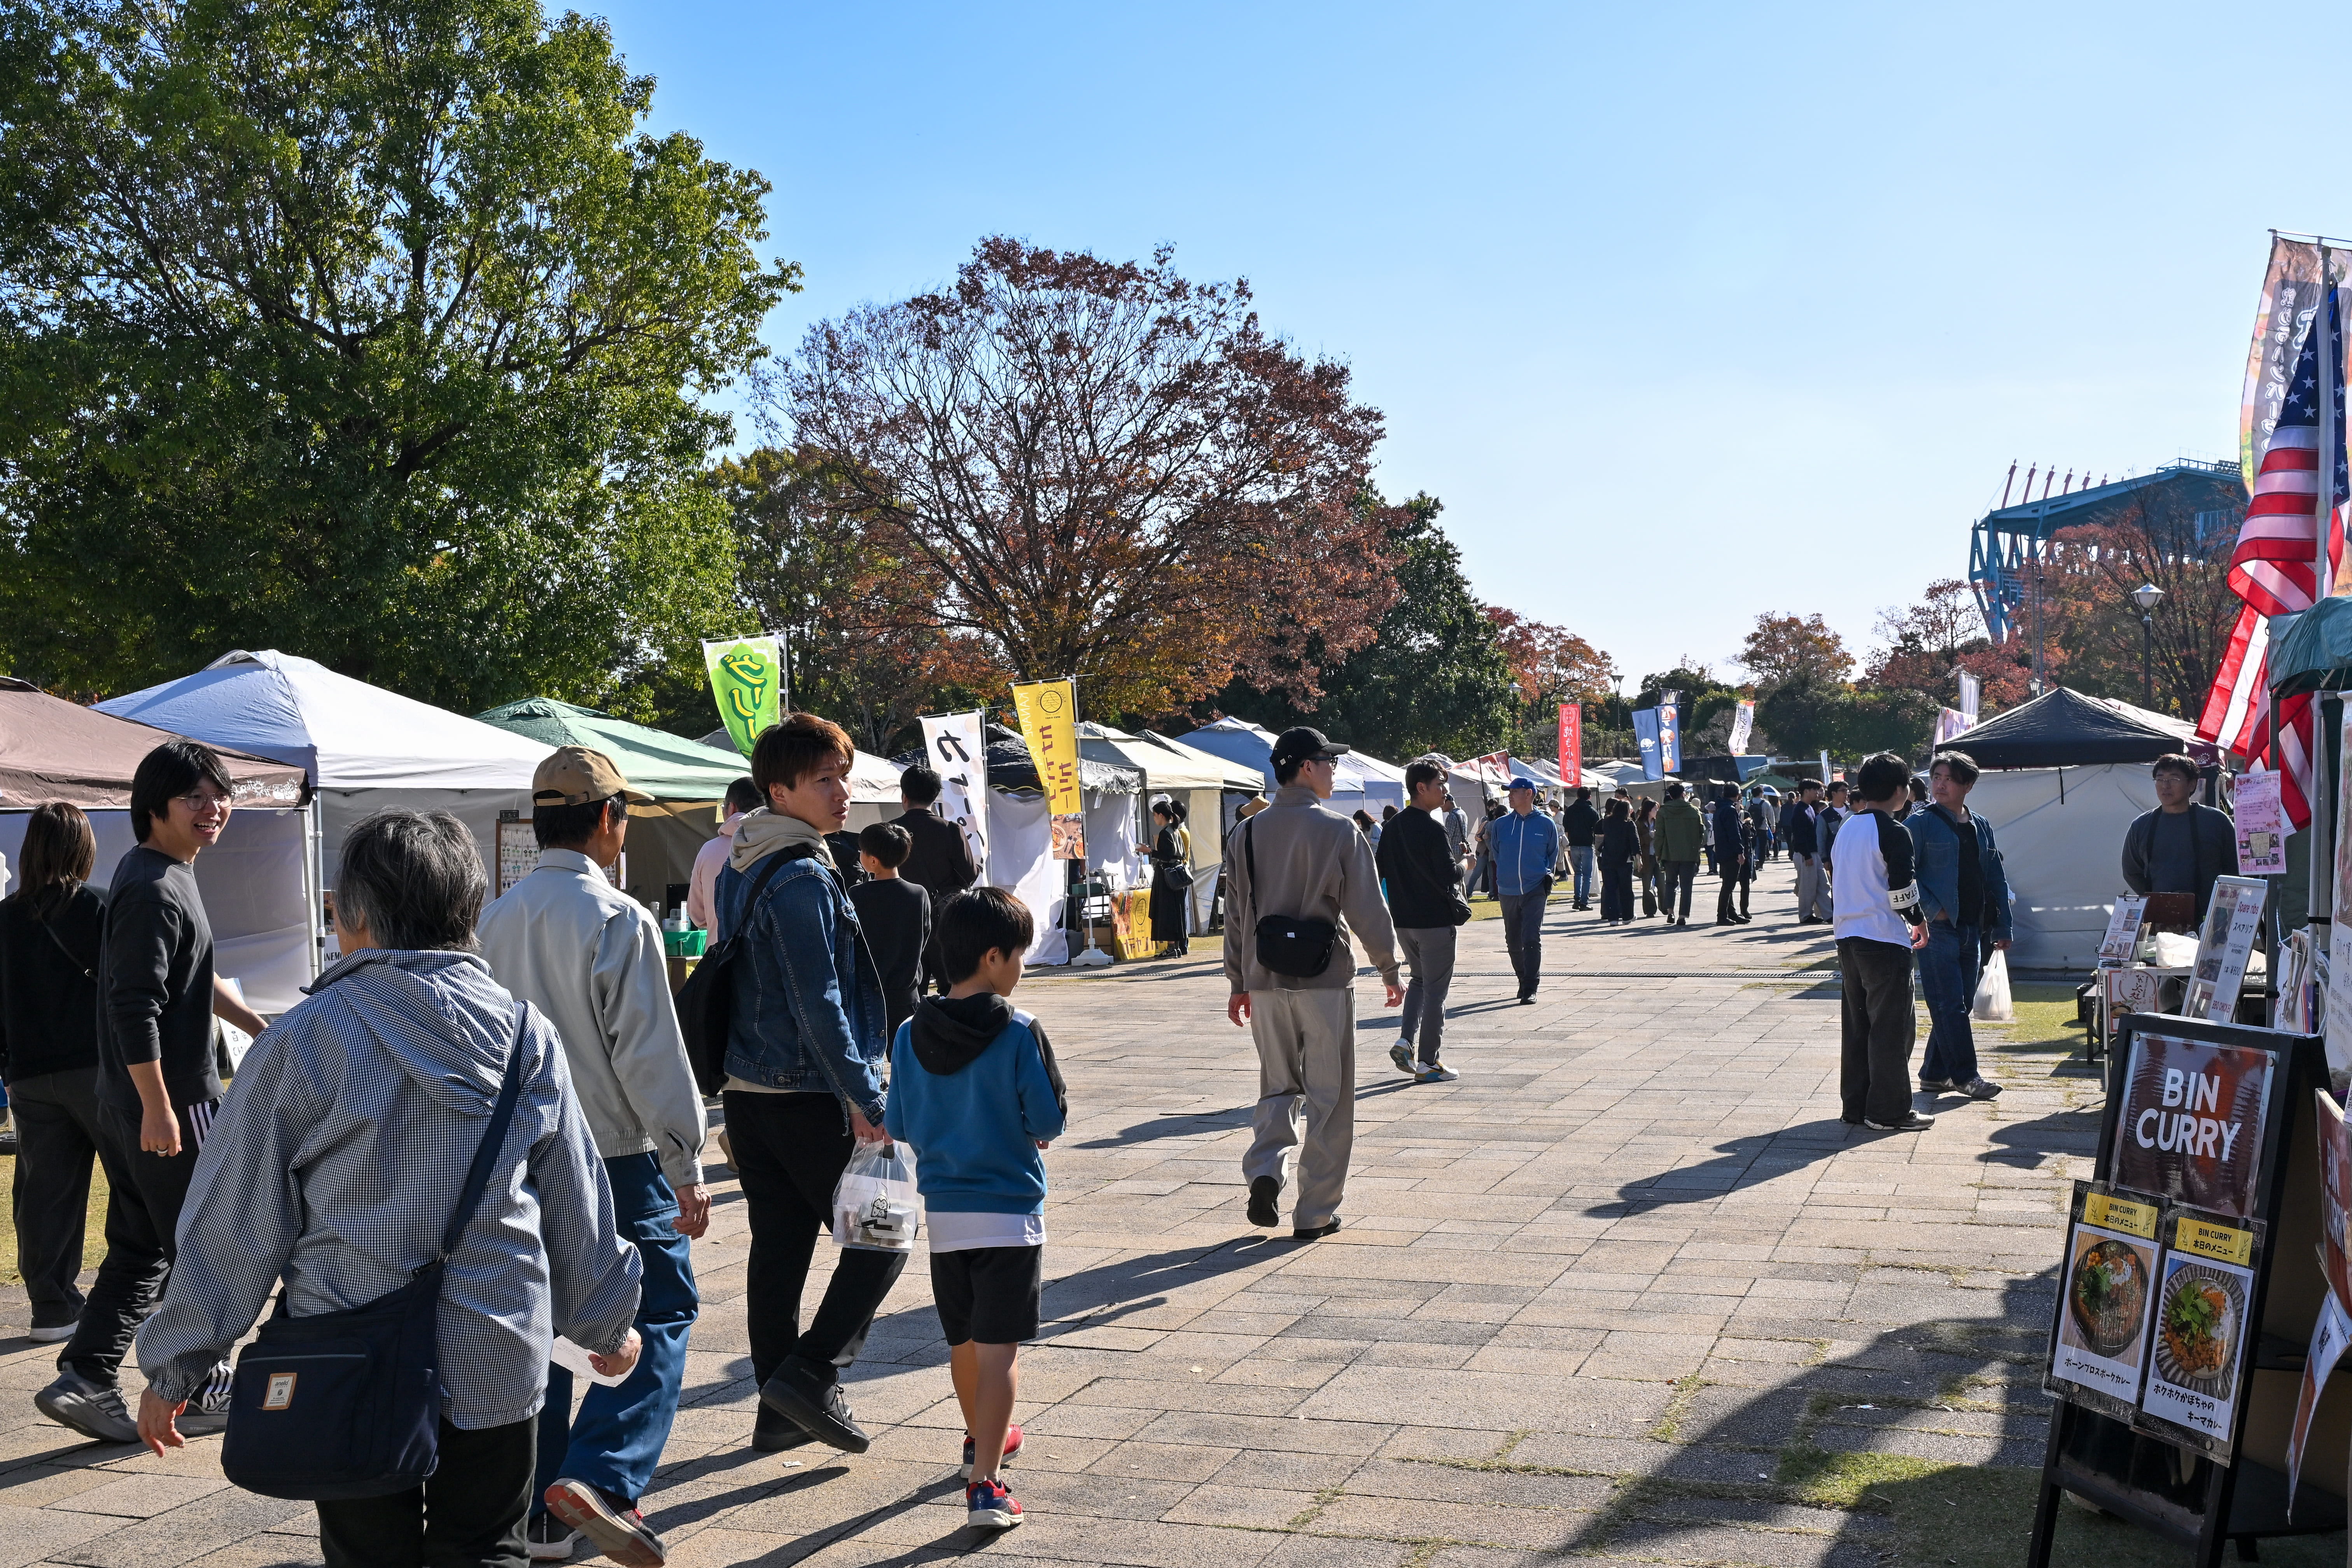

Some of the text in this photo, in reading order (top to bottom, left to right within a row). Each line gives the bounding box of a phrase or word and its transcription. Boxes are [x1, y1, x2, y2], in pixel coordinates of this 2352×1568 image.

[1893, 887, 1917, 903] STAFF
[2237, 901, 2250, 913] Spare
[2250, 903, 2259, 914] ribs
[2233, 922, 2254, 934] スペアリブ
[2230, 965, 2241, 976] ¥600
[2162, 1068, 2220, 1113] BIN
[2136, 1108, 2242, 1162] CURRY
[2327, 1138, 2340, 1197] BIN
[2109, 1203, 2137, 1216] BIN CURRY
[2104, 1213, 2138, 1228] 本日のメニュー
[2325, 1185, 2347, 1260] CURRY
[2198, 1228, 2232, 1242] BIN CURRY
[2193, 1239, 2233, 1255] 本日のメニュー
[2064, 1358, 2131, 1385] ボーンブロスポークカレー
[2153, 1383, 2214, 1412] ホクホクかぼちゃの
[2187, 1411, 2222, 1430] キーマカレー
